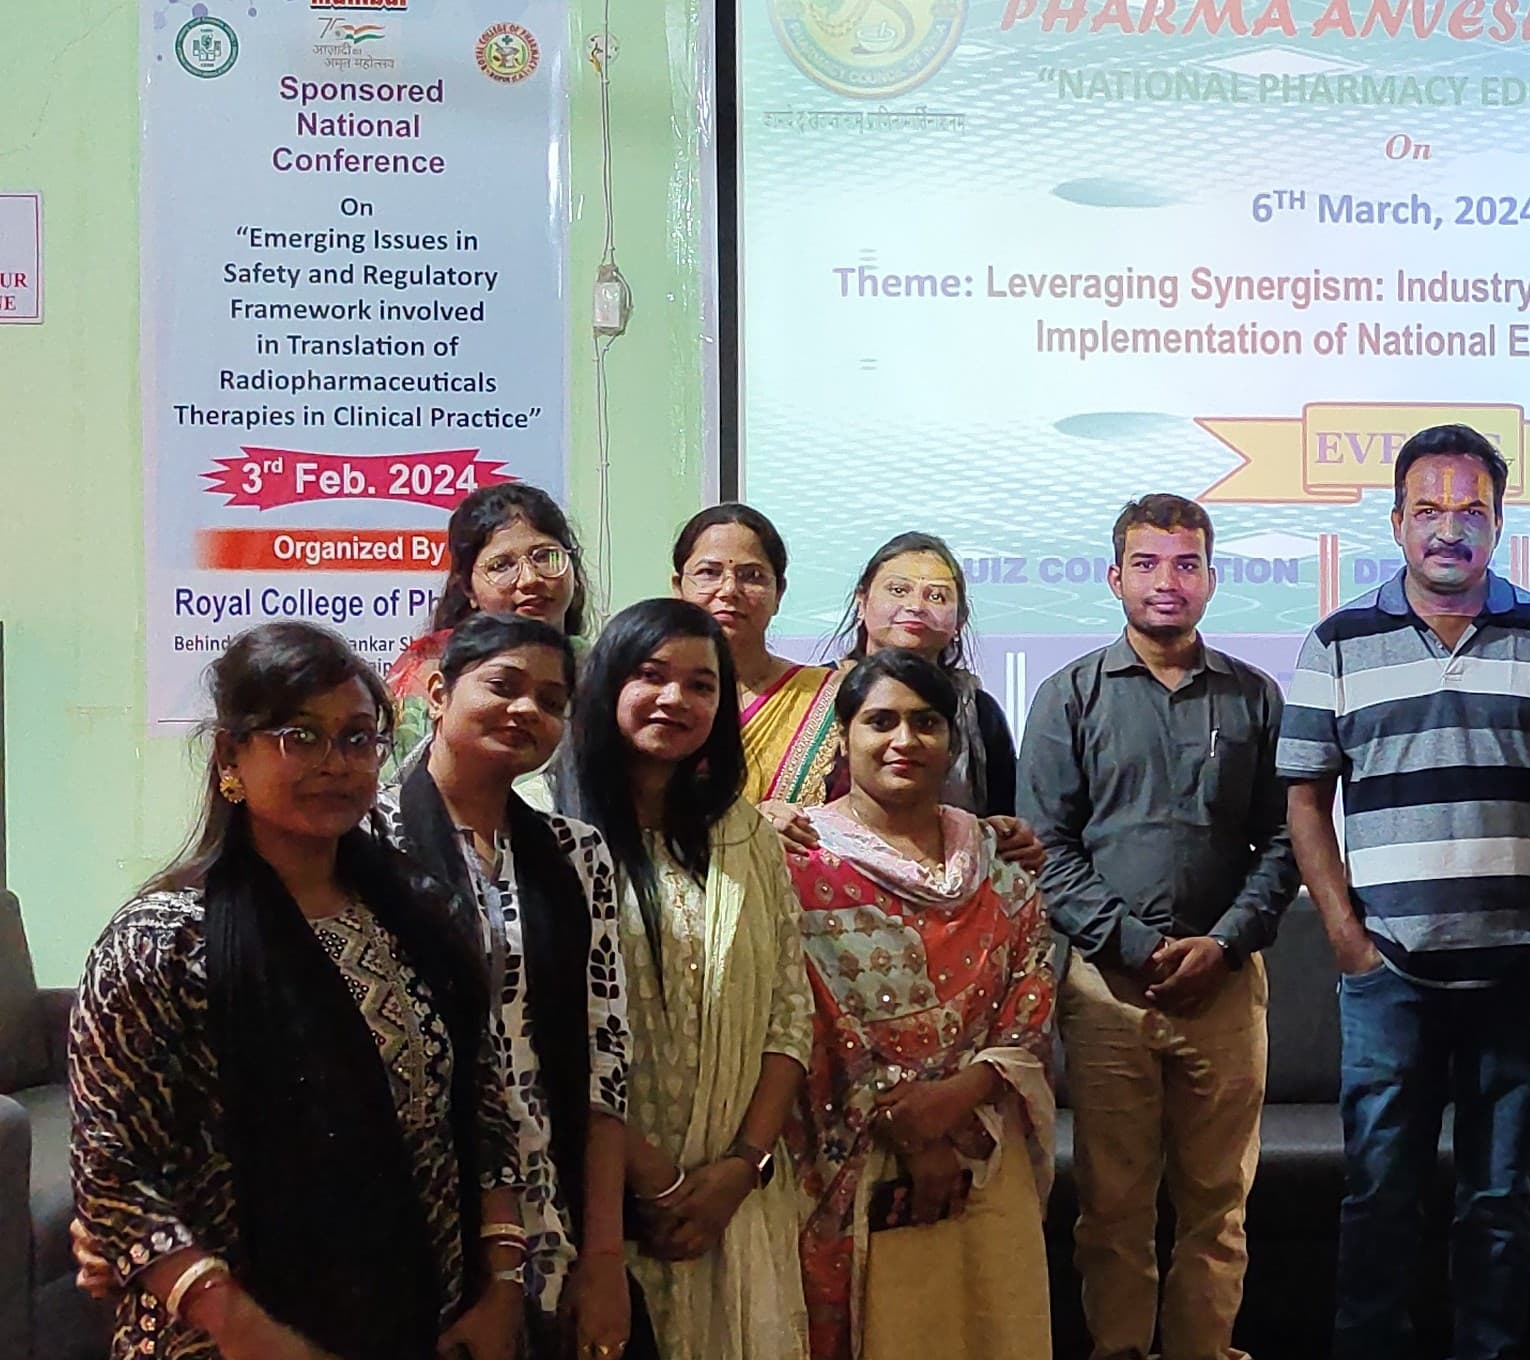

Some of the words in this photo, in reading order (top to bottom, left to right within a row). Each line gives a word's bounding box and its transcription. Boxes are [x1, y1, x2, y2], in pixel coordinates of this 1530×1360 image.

[280, 77, 444, 108] Sponsored
[1037, 67, 1249, 103] “NATIONAL
[1259, 72, 1470, 107] PHARMACY
[297, 112, 420, 138] National
[272, 147, 445, 173] Conference
[1385, 134, 1432, 160] On
[340, 197, 373, 217] On
[1318, 194, 1443, 230] March,
[236, 226, 366, 253] “Emerging
[373, 230, 448, 251] Issues
[456, 229, 478, 250] in
[223, 262, 300, 288] Safety
[308, 265, 354, 285] and
[363, 265, 498, 291] Regulatory
[833, 267, 974, 297] Theme:
[988, 266, 1179, 309] Leveraging
[1190, 267, 1384, 310] Synergism:
[230, 299, 371, 320] Framework
[379, 300, 485, 321] involved
[257, 335, 279, 355] in
[287, 335, 425, 357] Translation
[433, 336, 460, 357] of
[1037, 319, 1302, 360] Implementation
[1313, 321, 1348, 355] of
[1359, 322, 1496, 357] National
[220, 369, 496, 397] Radiopharmaceuticals
[174, 405, 295, 430] Therapies
[303, 406, 325, 426] in
[334, 406, 421, 428] Clinical
[430, 407, 541, 429] Practice”
[241, 456, 283, 495] 3rd
[296, 463, 376, 495] Feb.
[388, 463, 479, 496] 2024
[273, 535, 404, 565] Organized
[412, 536, 446, 567] By
[963, 557, 1028, 583] UIZ
[175, 588, 251, 622] Royal
[261, 588, 364, 623] College
[373, 589, 401, 616] of
